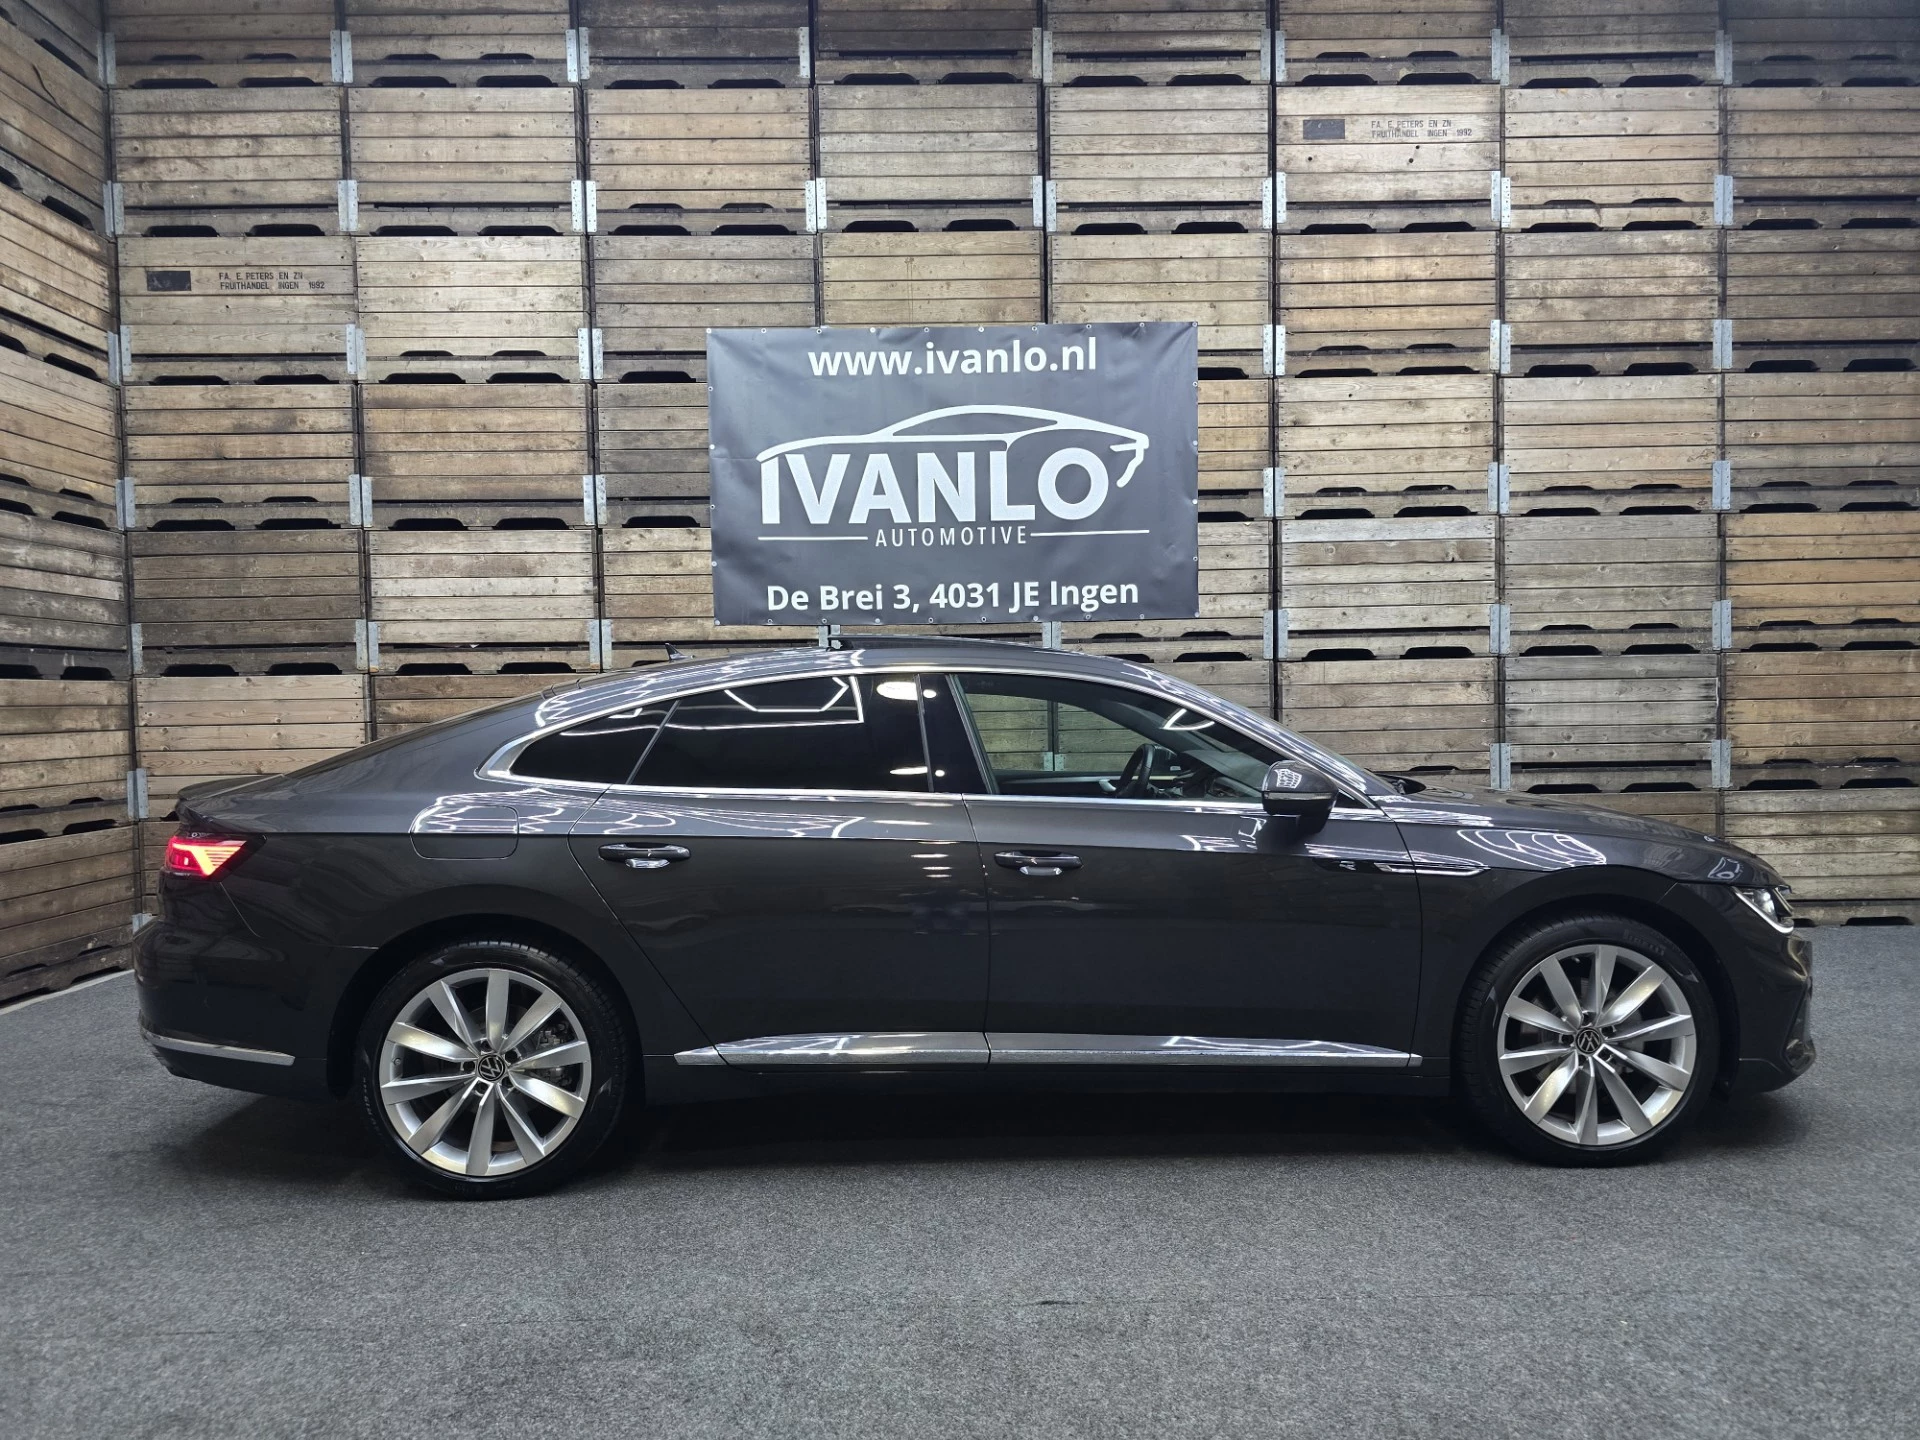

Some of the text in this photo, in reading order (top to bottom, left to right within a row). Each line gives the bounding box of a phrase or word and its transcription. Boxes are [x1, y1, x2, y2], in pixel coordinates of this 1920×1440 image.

[1397, 120, 1424, 128] PETERS
[1372, 129, 1418, 138] FRUITHANDEL
[1427, 129, 1448, 137] INGEN
[246, 272, 274, 280] PETERS
[220, 281, 325, 290] FRUITHANDEL INGEN 1992
[807, 336, 1098, 377] www.ivanlo.nl
[760, 446, 1110, 525] IVANLO
[875, 525, 1028, 548] AUTOMOTIVE
[767, 581, 1139, 615] De Brei 3, 4031 JE Ingen
